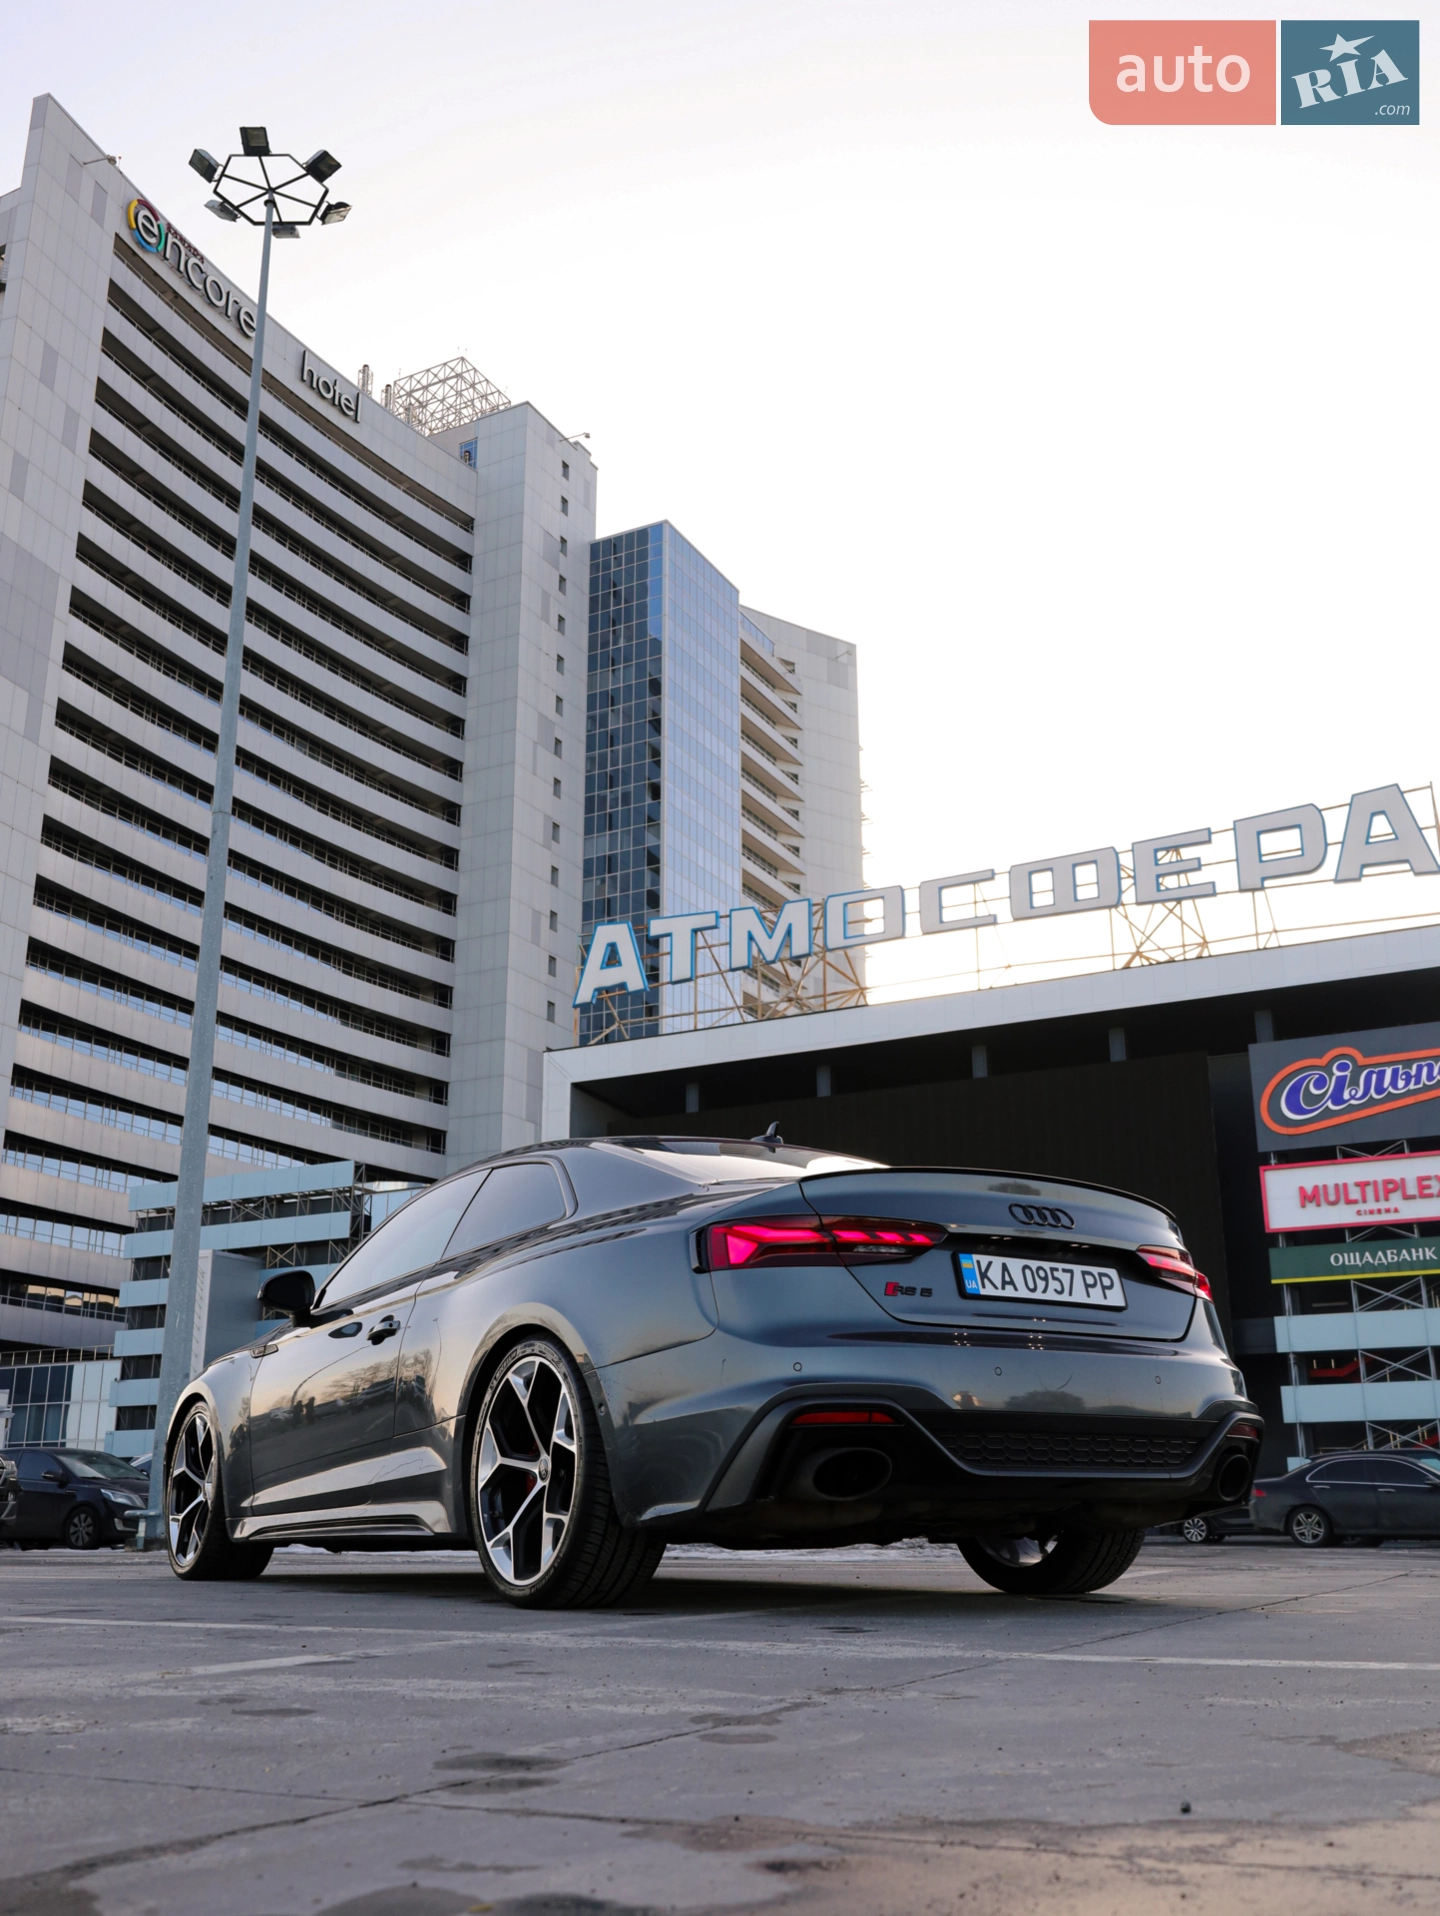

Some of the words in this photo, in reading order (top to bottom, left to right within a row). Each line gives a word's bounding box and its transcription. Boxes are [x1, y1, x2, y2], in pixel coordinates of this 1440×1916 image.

[136, 208, 256, 340] encore
[301, 349, 361, 424] hotel
[572, 783, 1440, 1008] АТМОСФЕРА
[1280, 1060, 1440, 1120] Сільп
[1356, 1206, 1400, 1216] CINEMA
[1330, 1246, 1438, 1267] ОЩАДБАНК
[965, 1279, 979, 1289] UA
[976, 1259, 1019, 1292] KA
[1021, 1264, 1074, 1297] 0957
[1081, 1269, 1115, 1300] PP
